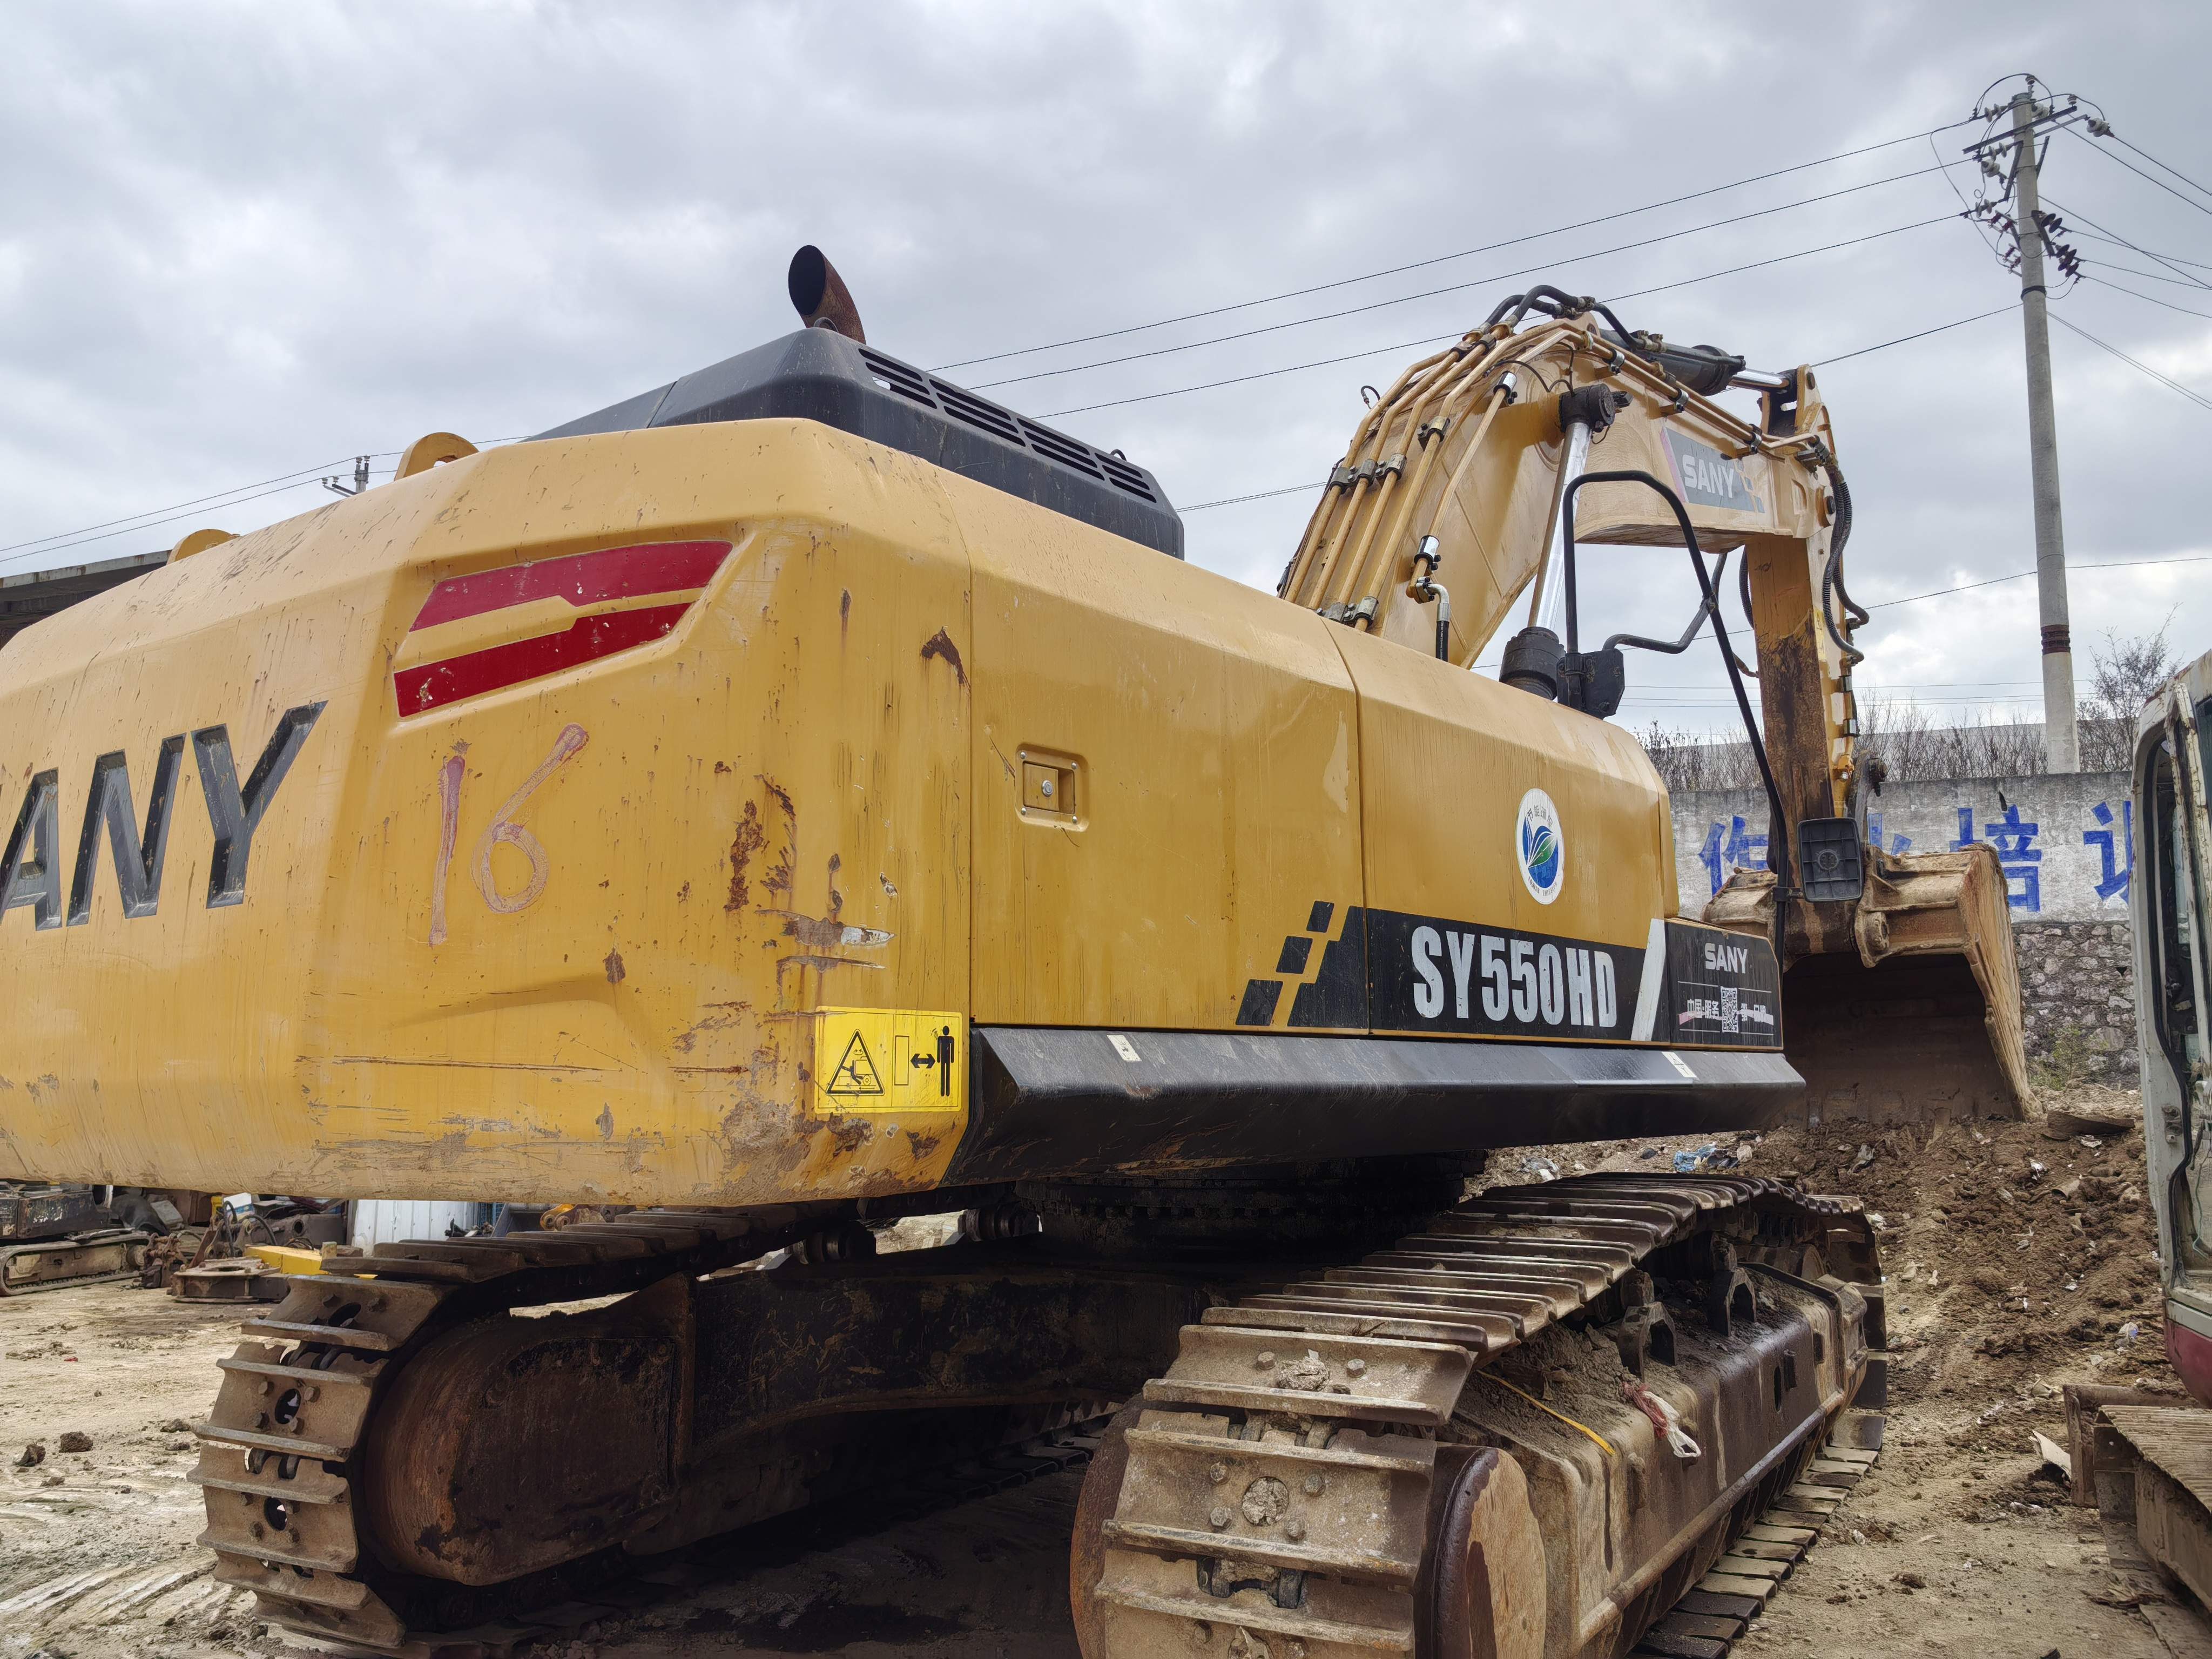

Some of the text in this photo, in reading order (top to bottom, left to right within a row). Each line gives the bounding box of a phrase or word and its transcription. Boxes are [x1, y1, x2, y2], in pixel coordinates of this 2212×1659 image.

[1682, 454, 1735, 498] SANY
[0, 700, 328, 932] ANY
[429, 723, 590, 946] 16
[1411, 926, 1617, 1028] SY550HD
[1704, 942, 1748, 974] SANY
